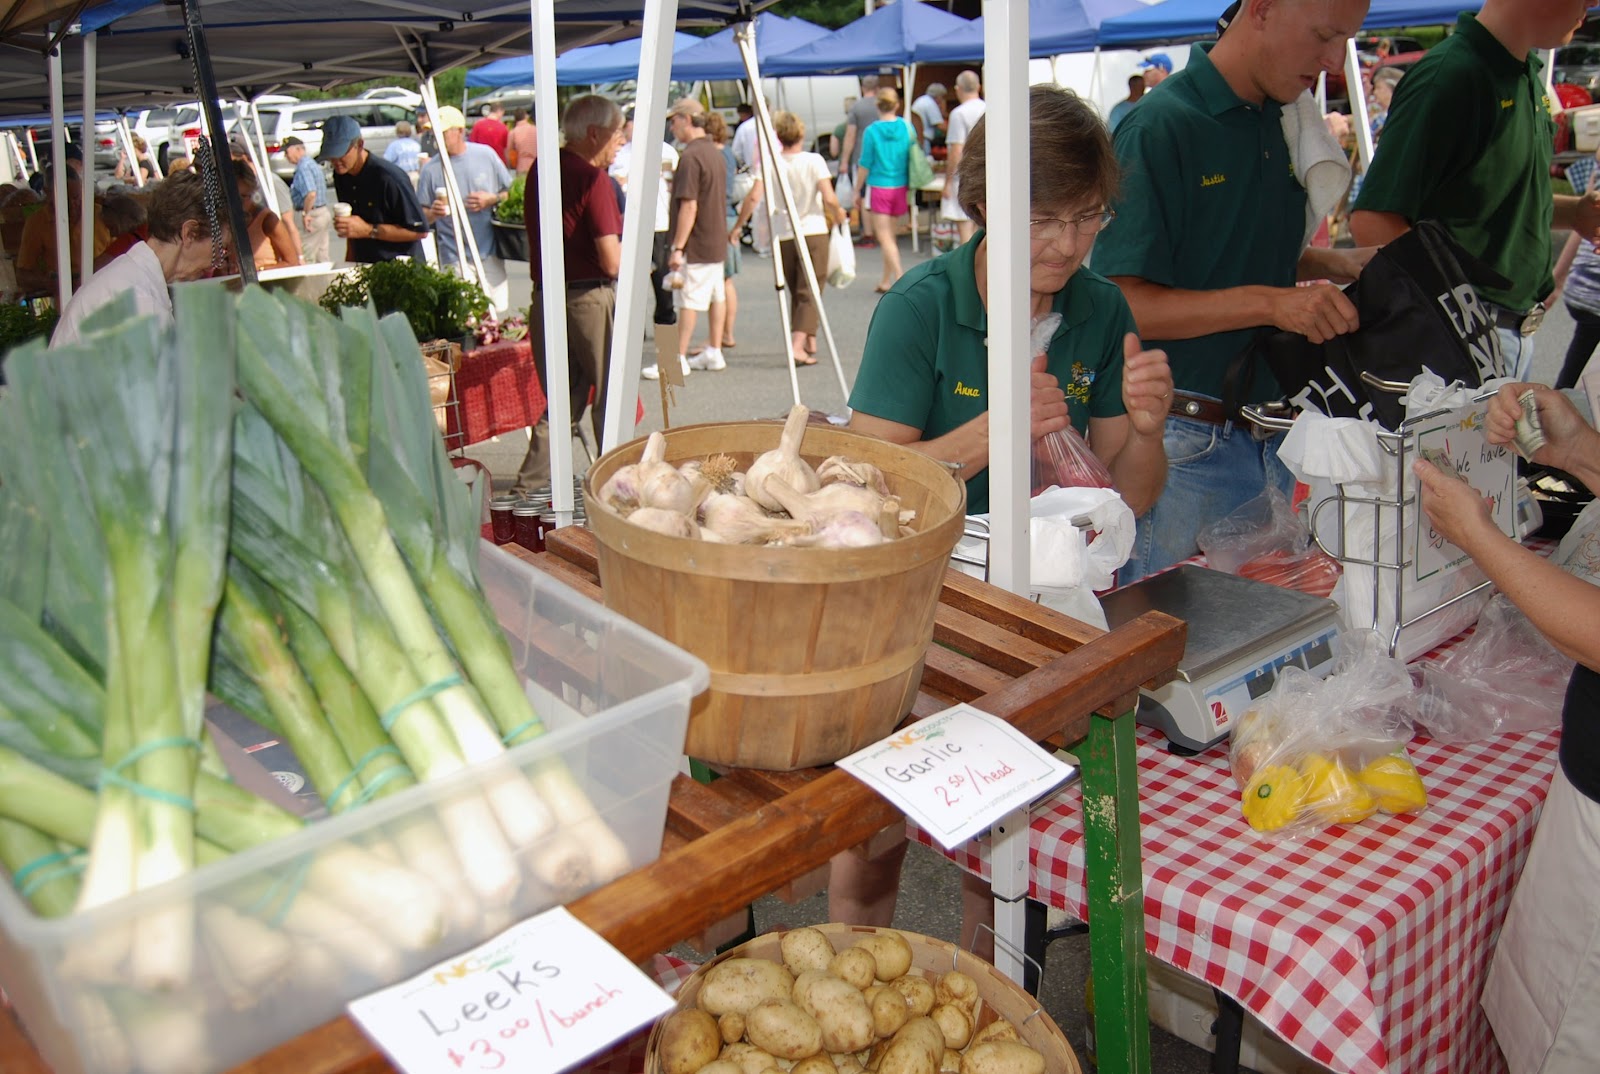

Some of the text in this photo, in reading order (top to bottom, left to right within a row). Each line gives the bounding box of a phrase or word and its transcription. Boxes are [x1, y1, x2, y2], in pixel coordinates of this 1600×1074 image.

[954, 381, 981, 398] Anna
[1456, 444, 1507, 473] We have
[884, 742, 963, 784] Garlic
[417, 960, 561, 1037] Leeks
